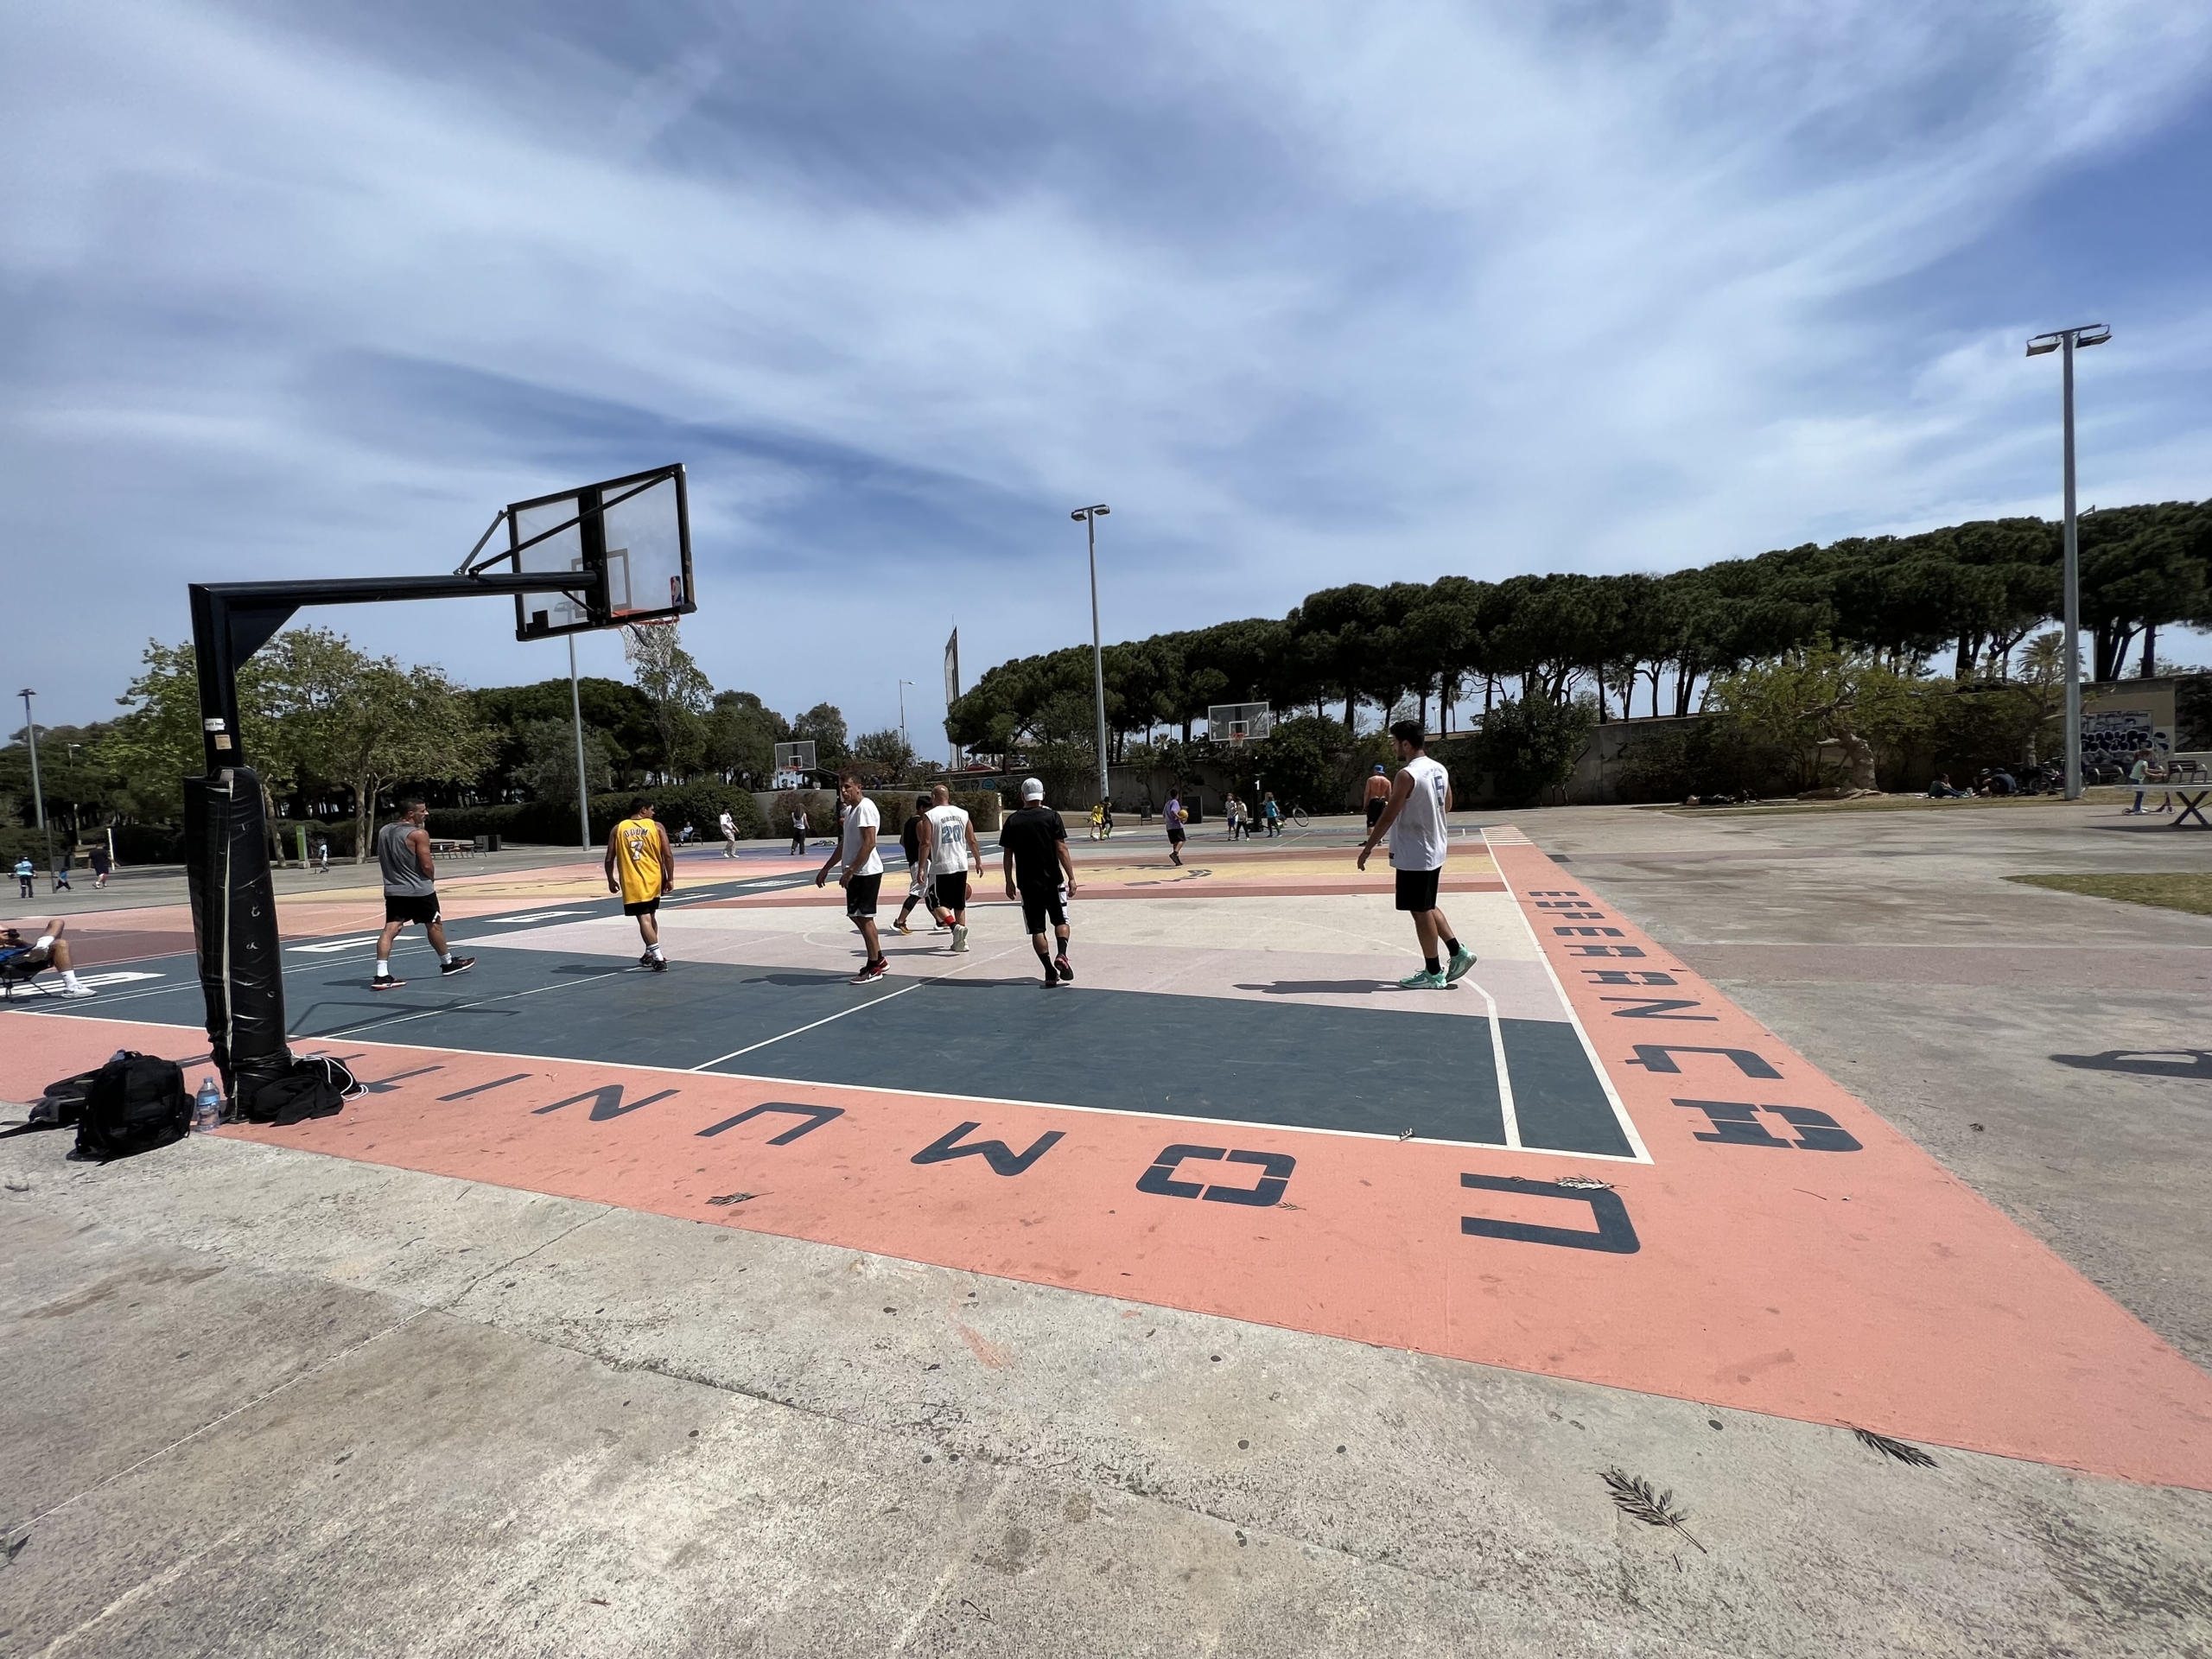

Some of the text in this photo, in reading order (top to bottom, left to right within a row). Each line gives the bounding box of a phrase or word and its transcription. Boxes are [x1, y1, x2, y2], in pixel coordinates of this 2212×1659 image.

[1255, 780, 1260, 791] 1
[623, 829, 648, 837] ODOM
[942, 824, 961, 843] 20
[630, 840, 644, 861] 7
[1528, 891, 1864, 1153] ESPERANÇA
[175, 1051, 1640, 1253] COMUNIT
